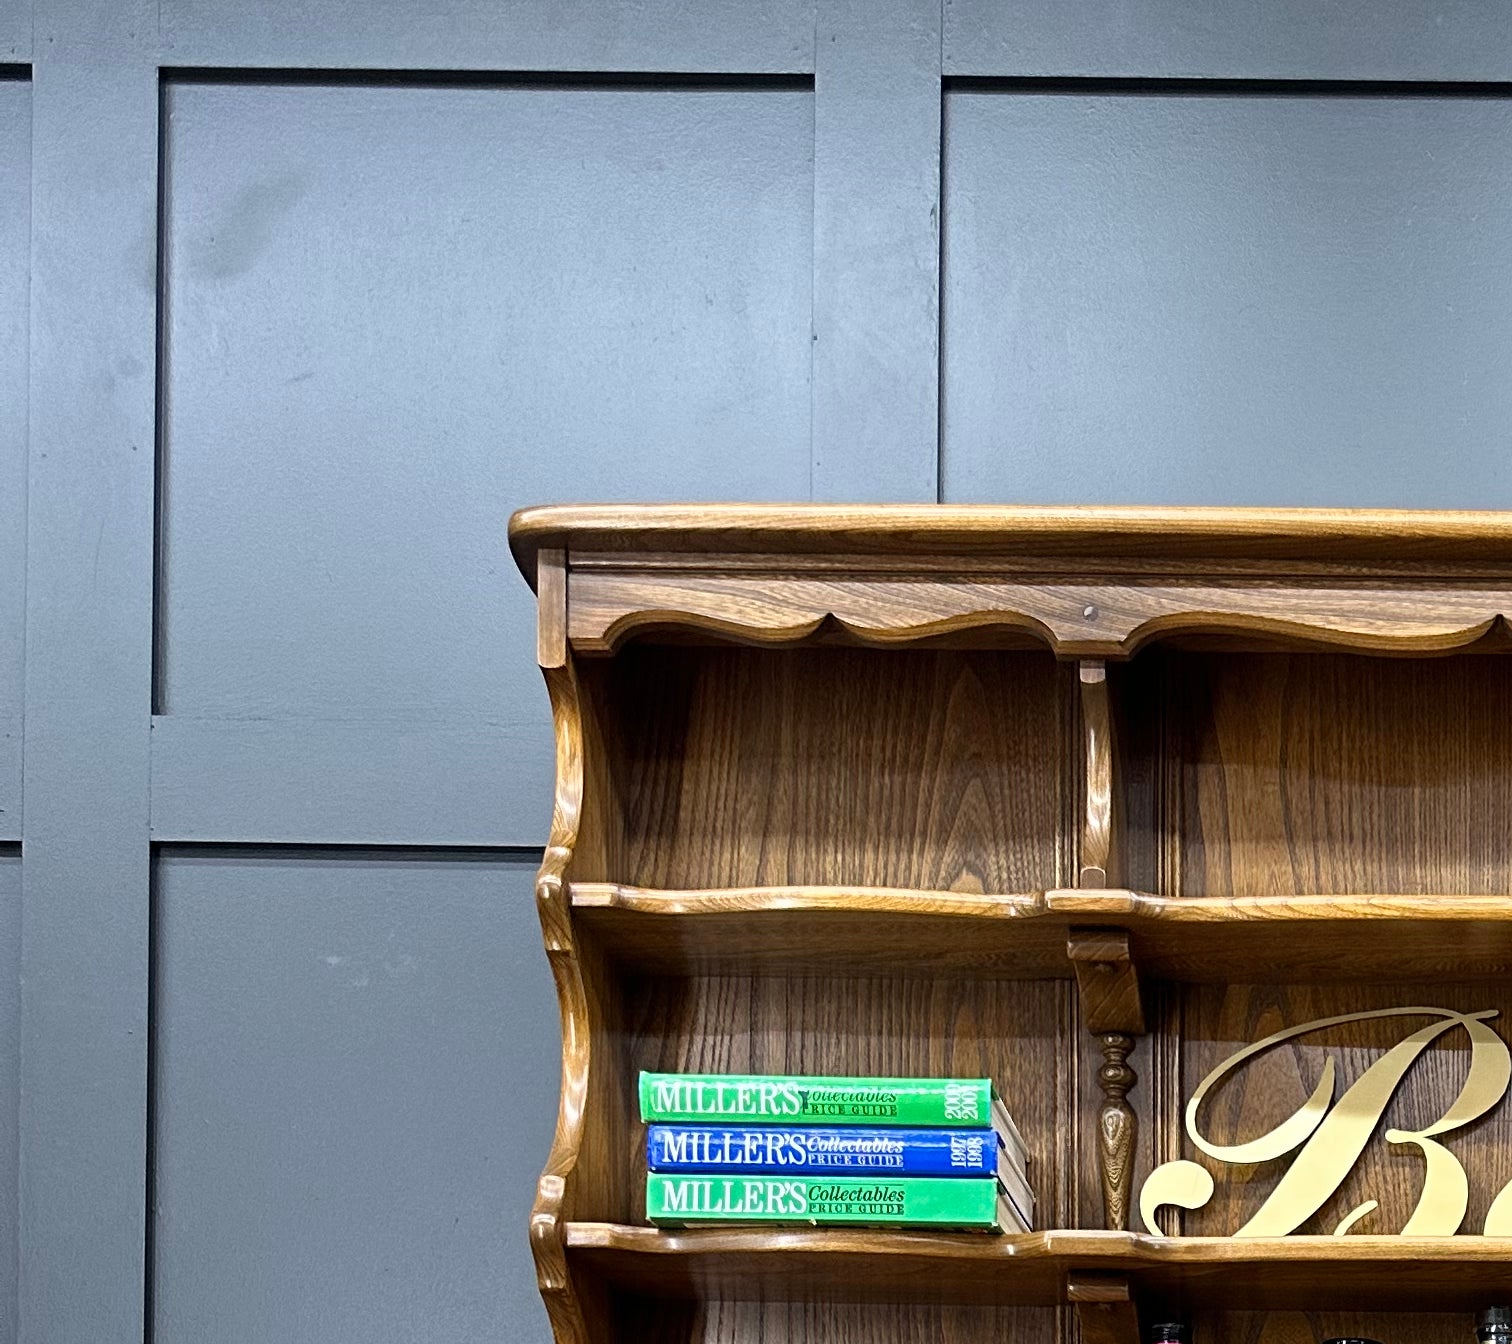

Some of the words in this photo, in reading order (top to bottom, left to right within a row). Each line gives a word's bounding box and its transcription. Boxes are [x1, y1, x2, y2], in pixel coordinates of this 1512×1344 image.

[655, 1081, 801, 1115] MILLER'S
[851, 1105, 898, 1117] GUIDE
[662, 1131, 807, 1165] MILLER'S
[807, 1135, 904, 1154] Collectables
[808, 1154, 855, 1166] PRICE
[857, 1155, 904, 1167] GUIDE
[967, 1137, 983, 1168] 1998
[662, 1181, 807, 1214] MILLER'S
[808, 1184, 905, 1202] Collectables
[808, 1203, 855, 1215] PRICE
[857, 1203, 905, 1215] GUIDE
